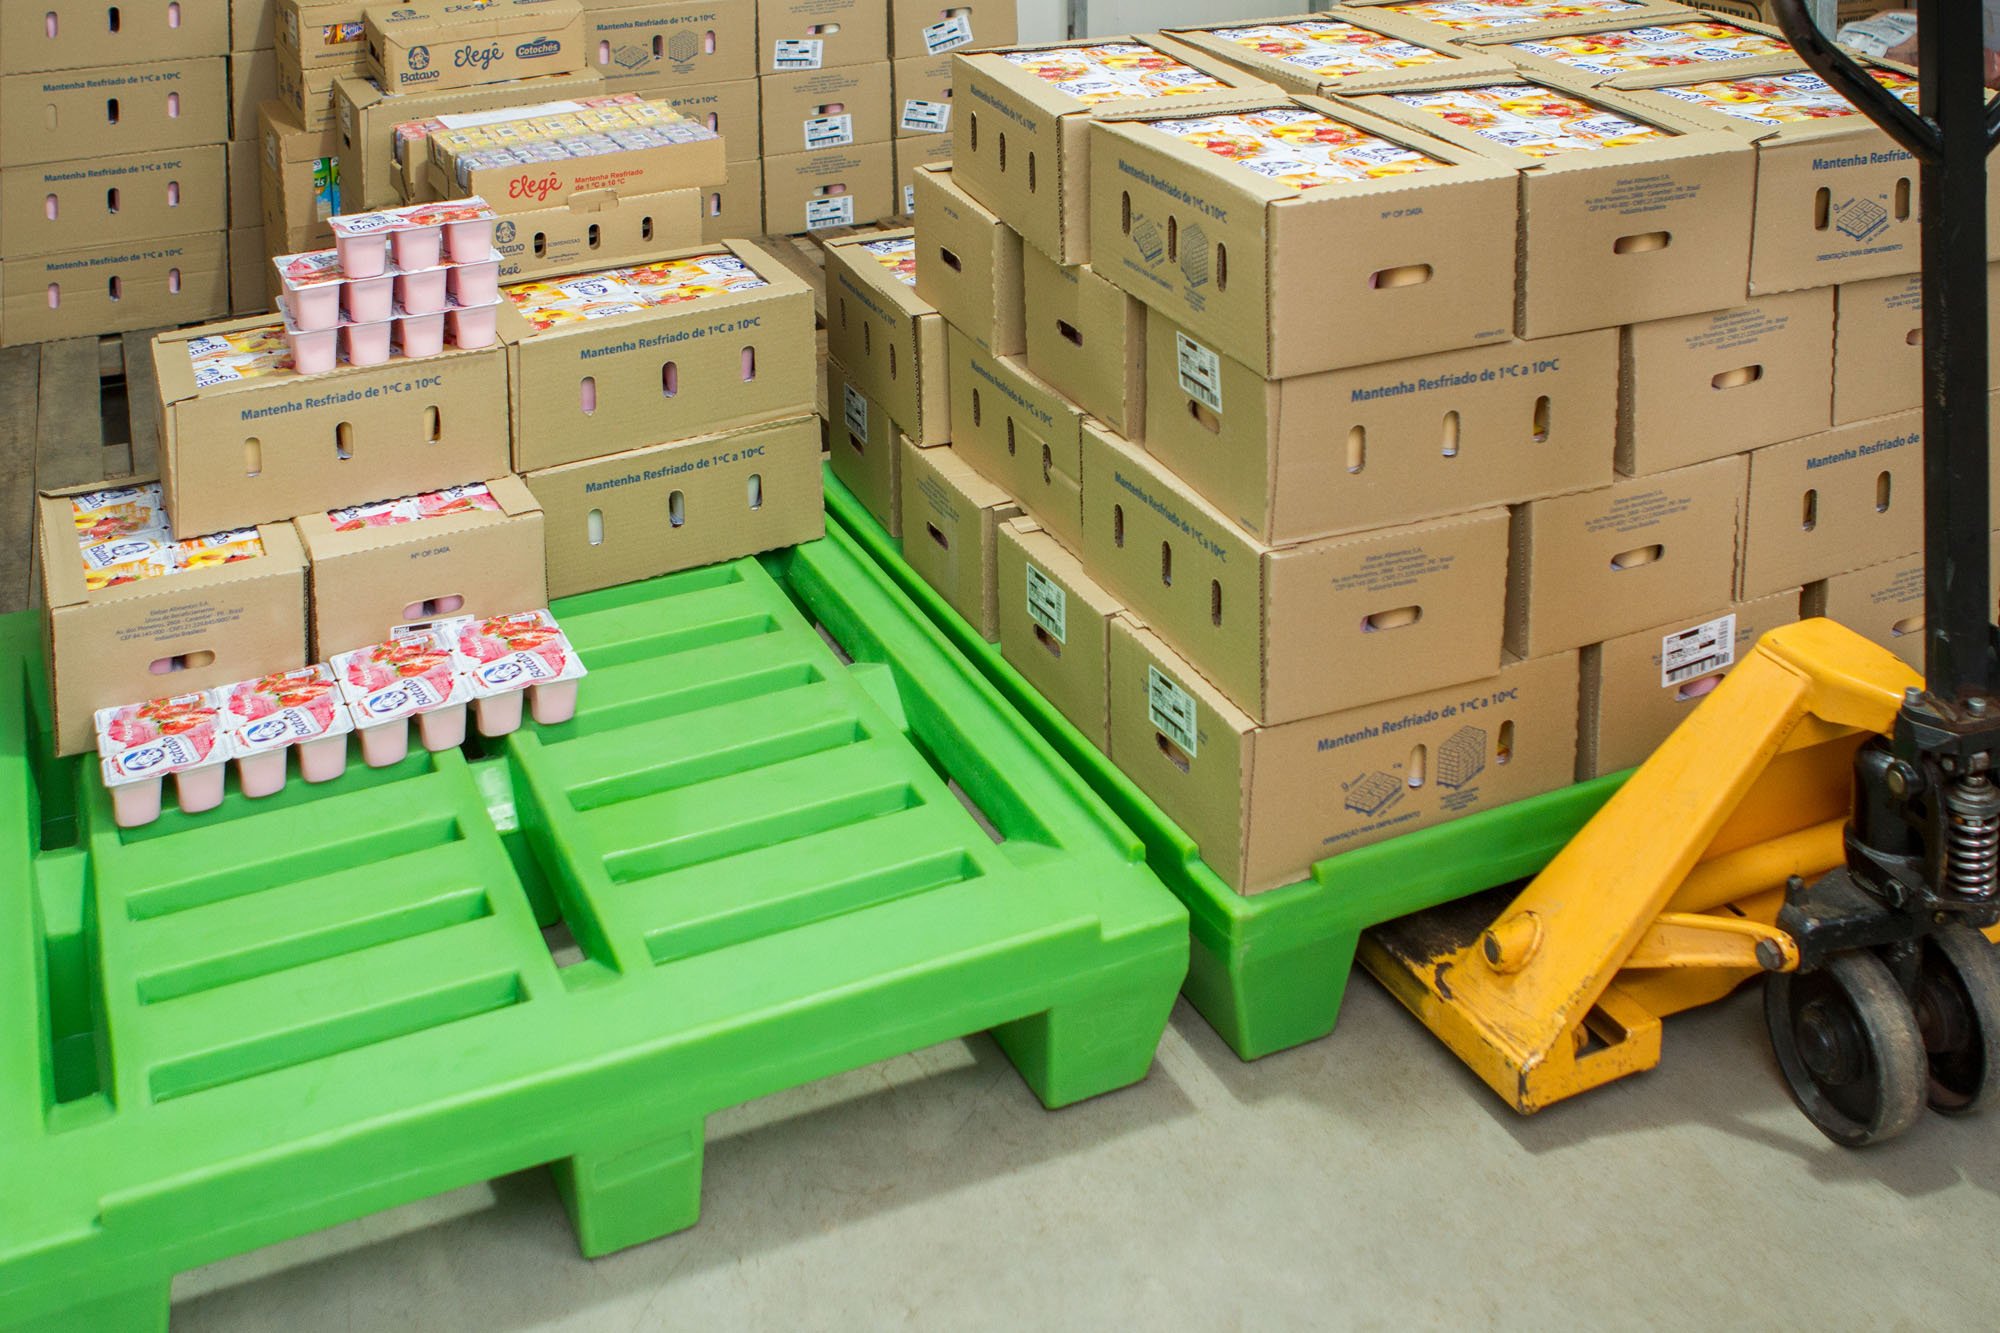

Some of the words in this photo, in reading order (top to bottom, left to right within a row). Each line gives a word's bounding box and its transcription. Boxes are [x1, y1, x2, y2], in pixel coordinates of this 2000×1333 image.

[597, 22, 633, 30] Mantenha
[635, 19, 668, 27] Resfriado
[454, 42, 503, 70] Elegê
[43, 82, 85, 92] Mantenha
[87, 78, 125, 88] Resfriado
[163, 72, 181, 80] 10ºC
[400, 70, 439, 82] Batavo
[44, 172, 85, 182] Mantenha
[88, 168, 126, 177] Resfriado
[163, 161, 182, 169] 10ºC
[1812, 155, 1867, 170] Mantenha
[1871, 151, 1912, 164] Resfriad
[509, 172, 562, 201] Elegê
[575, 174, 609, 184] Mantenha
[611, 169, 643, 179] Resfriado
[47, 261, 89, 270] Mantenha
[90, 256, 128, 265] Resfriado
[165, 248, 183, 256] 10ºC
[581, 343, 636, 359] Mantenha
[639, 332, 689, 348] Resfriado
[692, 328, 705, 338] de
[709, 323, 725, 335] 1ºC
[738, 317, 760, 330] 10ºC
[1352, 383, 1415, 402] Mantenha
[1419, 372, 1476, 390] Resfriado
[1480, 369, 1495, 380] de
[1500, 365, 1519, 378] 1ºC
[1522, 367, 1528, 375] a
[1533, 359, 1559, 373] 10ºC
[241, 404, 302, 420] Mantenha
[306, 392, 361, 408] Resfriado
[365, 387, 379, 398] de
[383, 383, 402, 395] 1ºC
[415, 376, 441, 389] 10ºC
[1807, 449, 1856, 469] Mantenha
[1859, 437, 1904, 455] Resfriado
[1908, 433, 1920, 444] de
[586, 475, 640, 493] Mantenha
[644, 464, 694, 480] Resfriado
[697, 459, 709, 468] de
[713, 454, 729, 465] 1ºC
[742, 446, 765, 459] 10ºC
[1317, 727, 1379, 751] Mantenha
[1382, 710, 1439, 734] Resfriado
[1442, 706, 1456, 717] de
[1460, 698, 1478, 713] 1ºC
[1481, 698, 1488, 707] a
[1492, 688, 1518, 704] 10ºC
